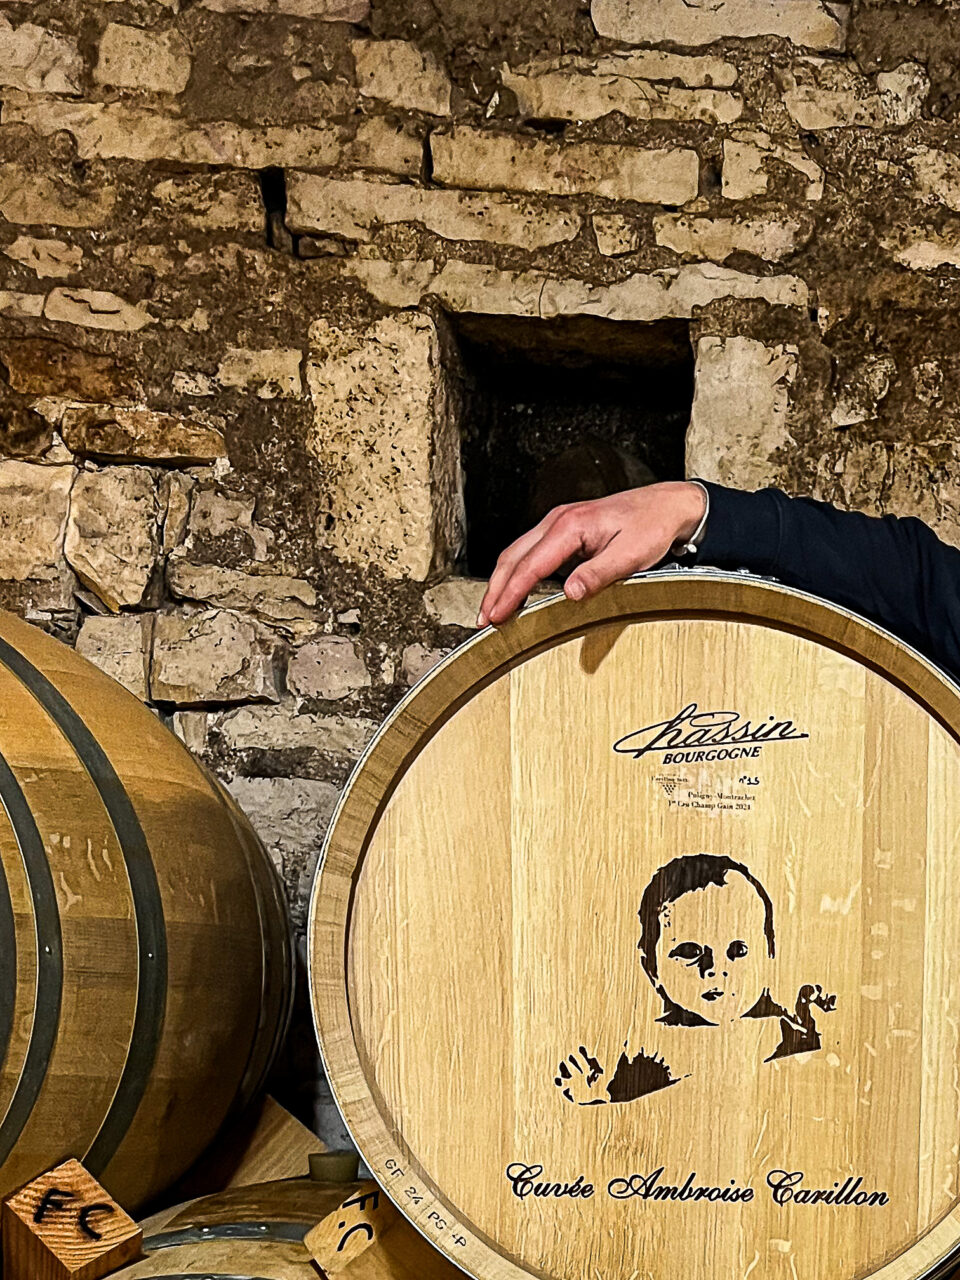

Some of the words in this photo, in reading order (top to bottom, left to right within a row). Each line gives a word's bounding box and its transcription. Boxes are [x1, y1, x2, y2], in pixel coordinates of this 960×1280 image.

[613, 702, 809, 760] Chassin
[663, 746, 762, 765] BOURGOGNE
[506, 1162, 595, 1201] Cuvée
[607, 1166, 755, 1203] Ambroise
[766, 1169, 890, 1208] Carillon
